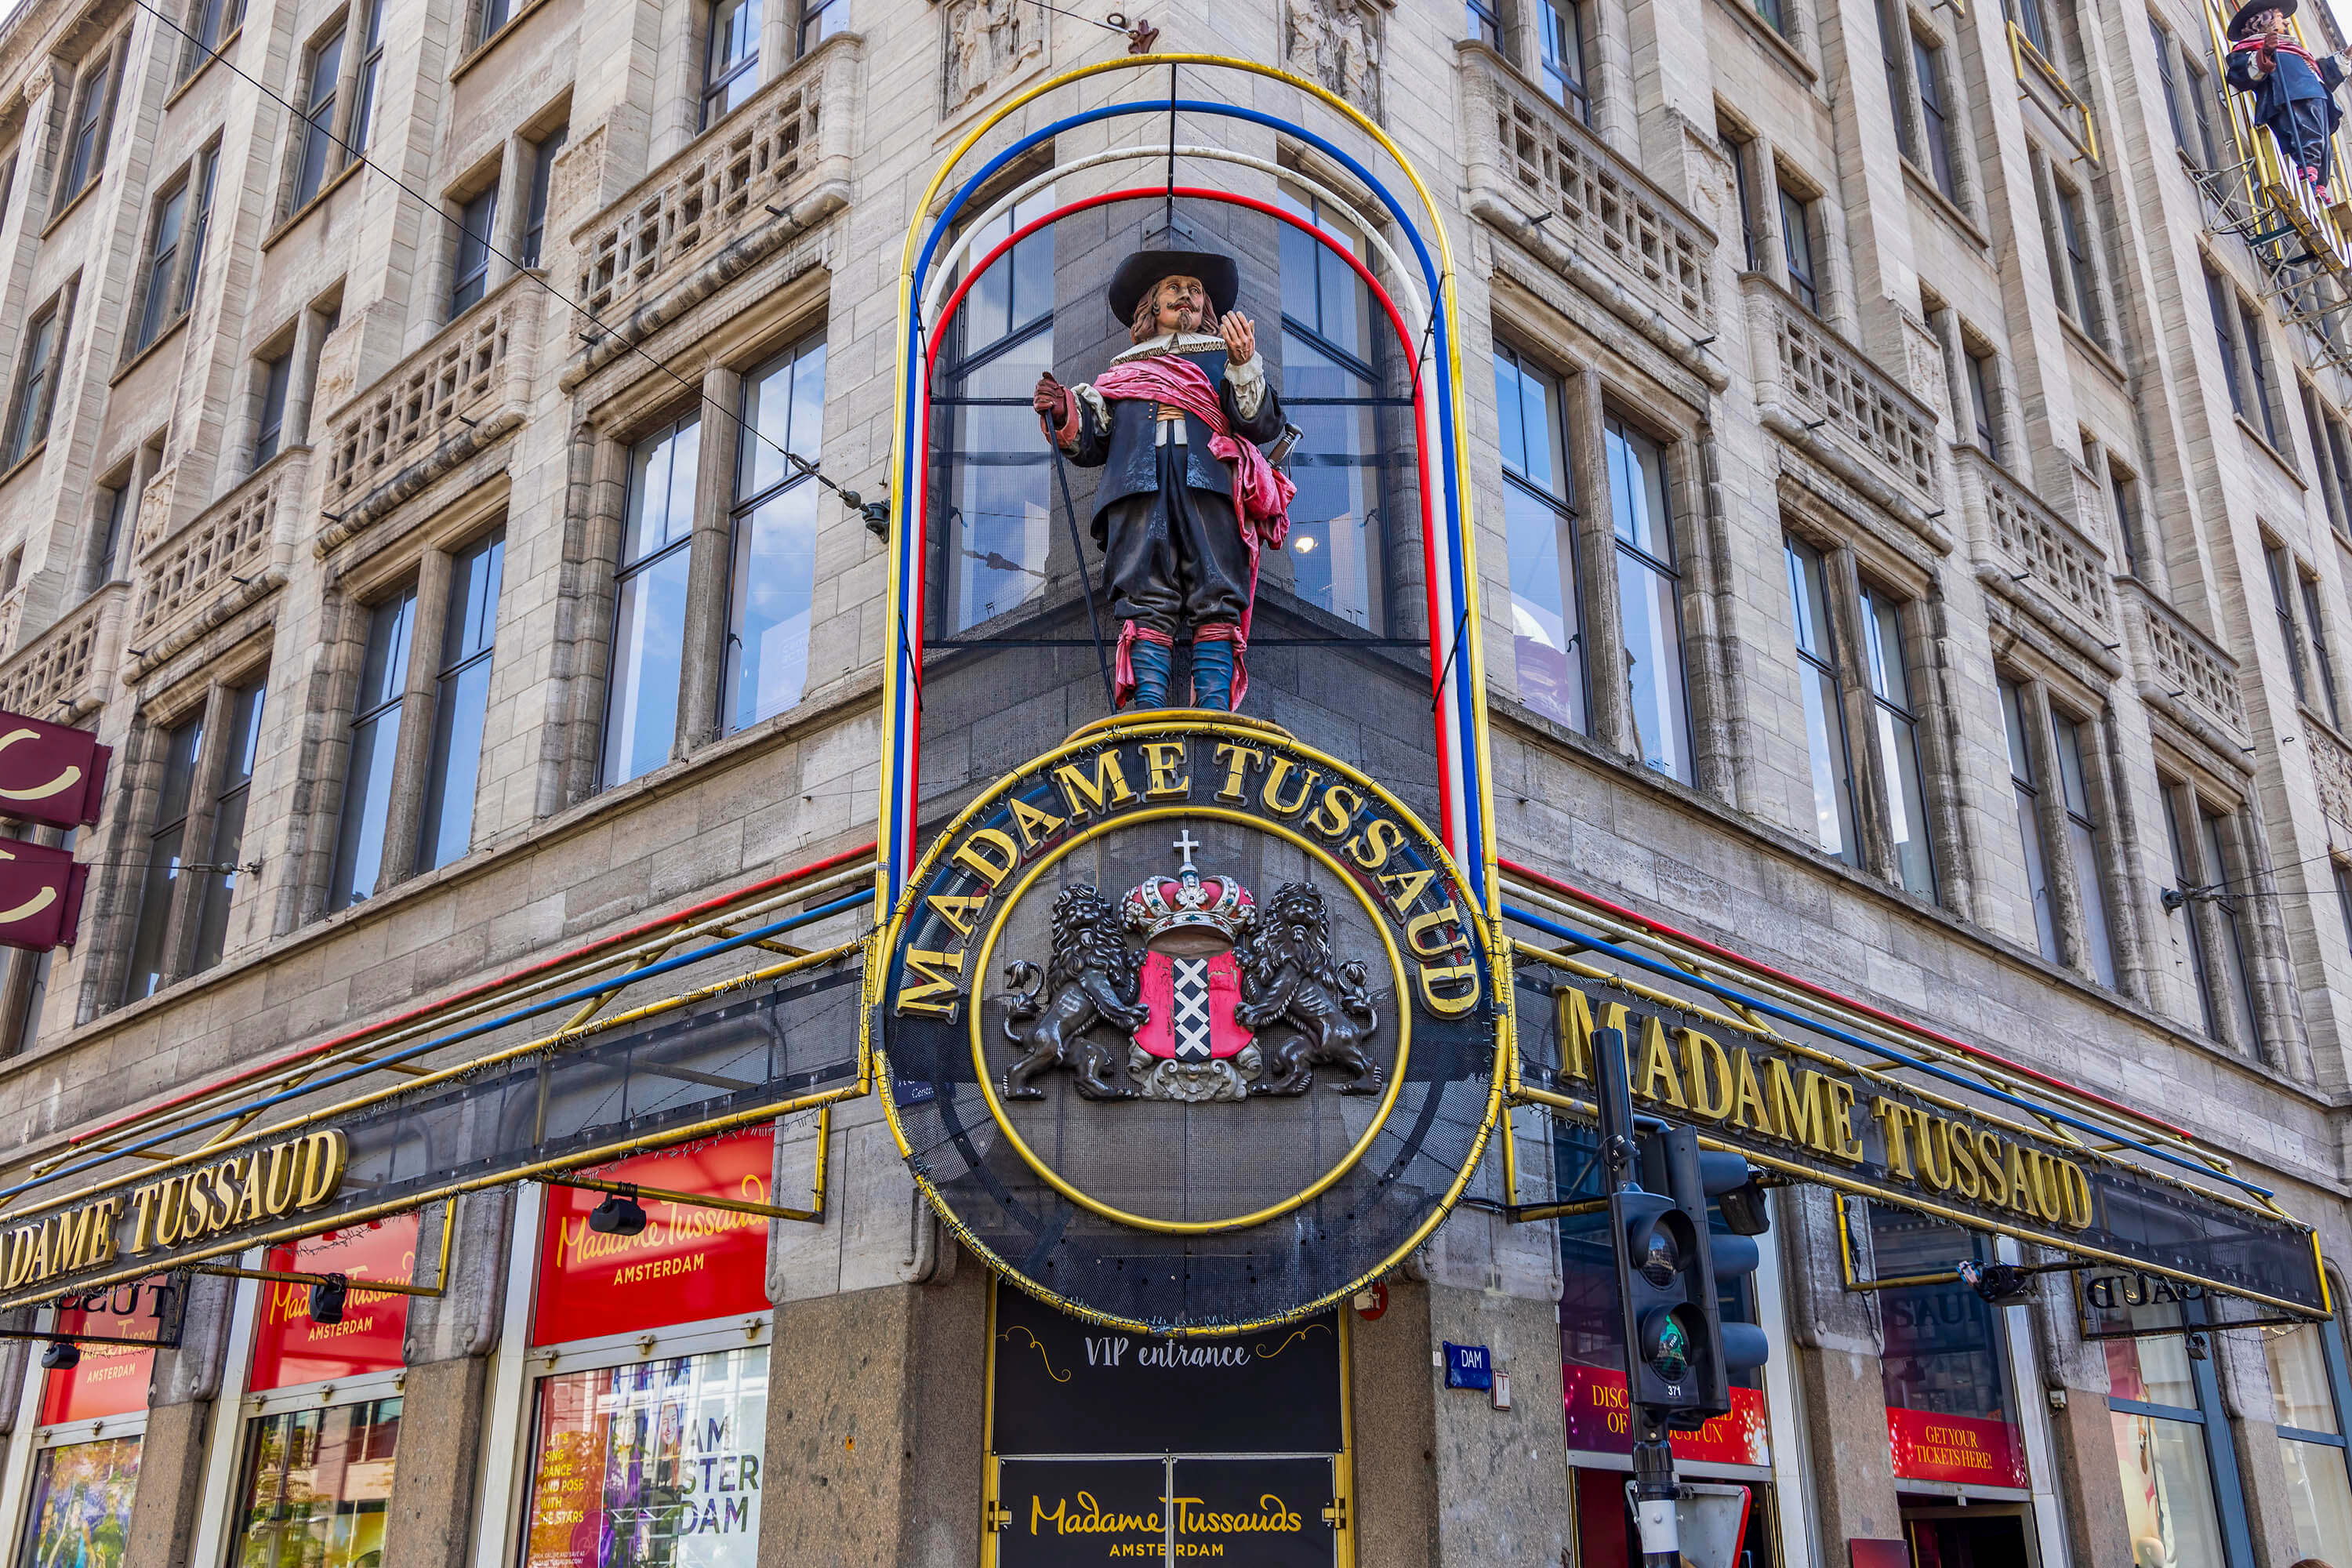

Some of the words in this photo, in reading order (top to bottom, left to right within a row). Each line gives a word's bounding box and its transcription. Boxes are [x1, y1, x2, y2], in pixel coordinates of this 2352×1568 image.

[895, 741, 1191, 1025] MADAME
[1213, 742, 1483, 1022] TUSSAUD
[1555, 985, 1864, 1165] MADAME
[1872, 1095, 2092, 1233] TUSSAUD
[0, 1196, 124, 1290] DAME
[130, 1129, 348, 1254] TUSSAUD
[614, 1254, 704, 1286] AMSTERDAM
[308, 1316, 373, 1341] AMSTERDAM
[1085, 1336, 1129, 1367] VIP
[1138, 1338, 1250, 1367] entrance
[1461, 1349, 1482, 1369] DAM
[86, 1363, 136, 1384] AMSTERDAM
[1668, 1385, 1682, 1396] 371
[1607, 1412, 1628, 1434] OF
[546, 1433, 568, 1446] LET'S
[1926, 1425, 1948, 1444] GET
[1948, 1428, 1978, 1449] YOUR
[545, 1450, 564, 1462] SING
[1915, 1445, 1960, 1466] TICKETS
[1961, 1450, 1992, 1470] HERE!
[543, 1464, 572, 1477] DANCE
[681, 1454, 759, 1494] STER
[542, 1481, 559, 1494] AND
[561, 1479, 583, 1491] POSE
[541, 1496, 562, 1509] WITH
[1031, 1490, 1167, 1536] Madame
[1158, 1494, 1301, 1534] Tussauds
[539, 1512, 553, 1525] THE
[556, 1511, 584, 1525] STARS
[678, 1497, 748, 1535] DAM
[1109, 1543, 1224, 1557] AMSTERDAM
